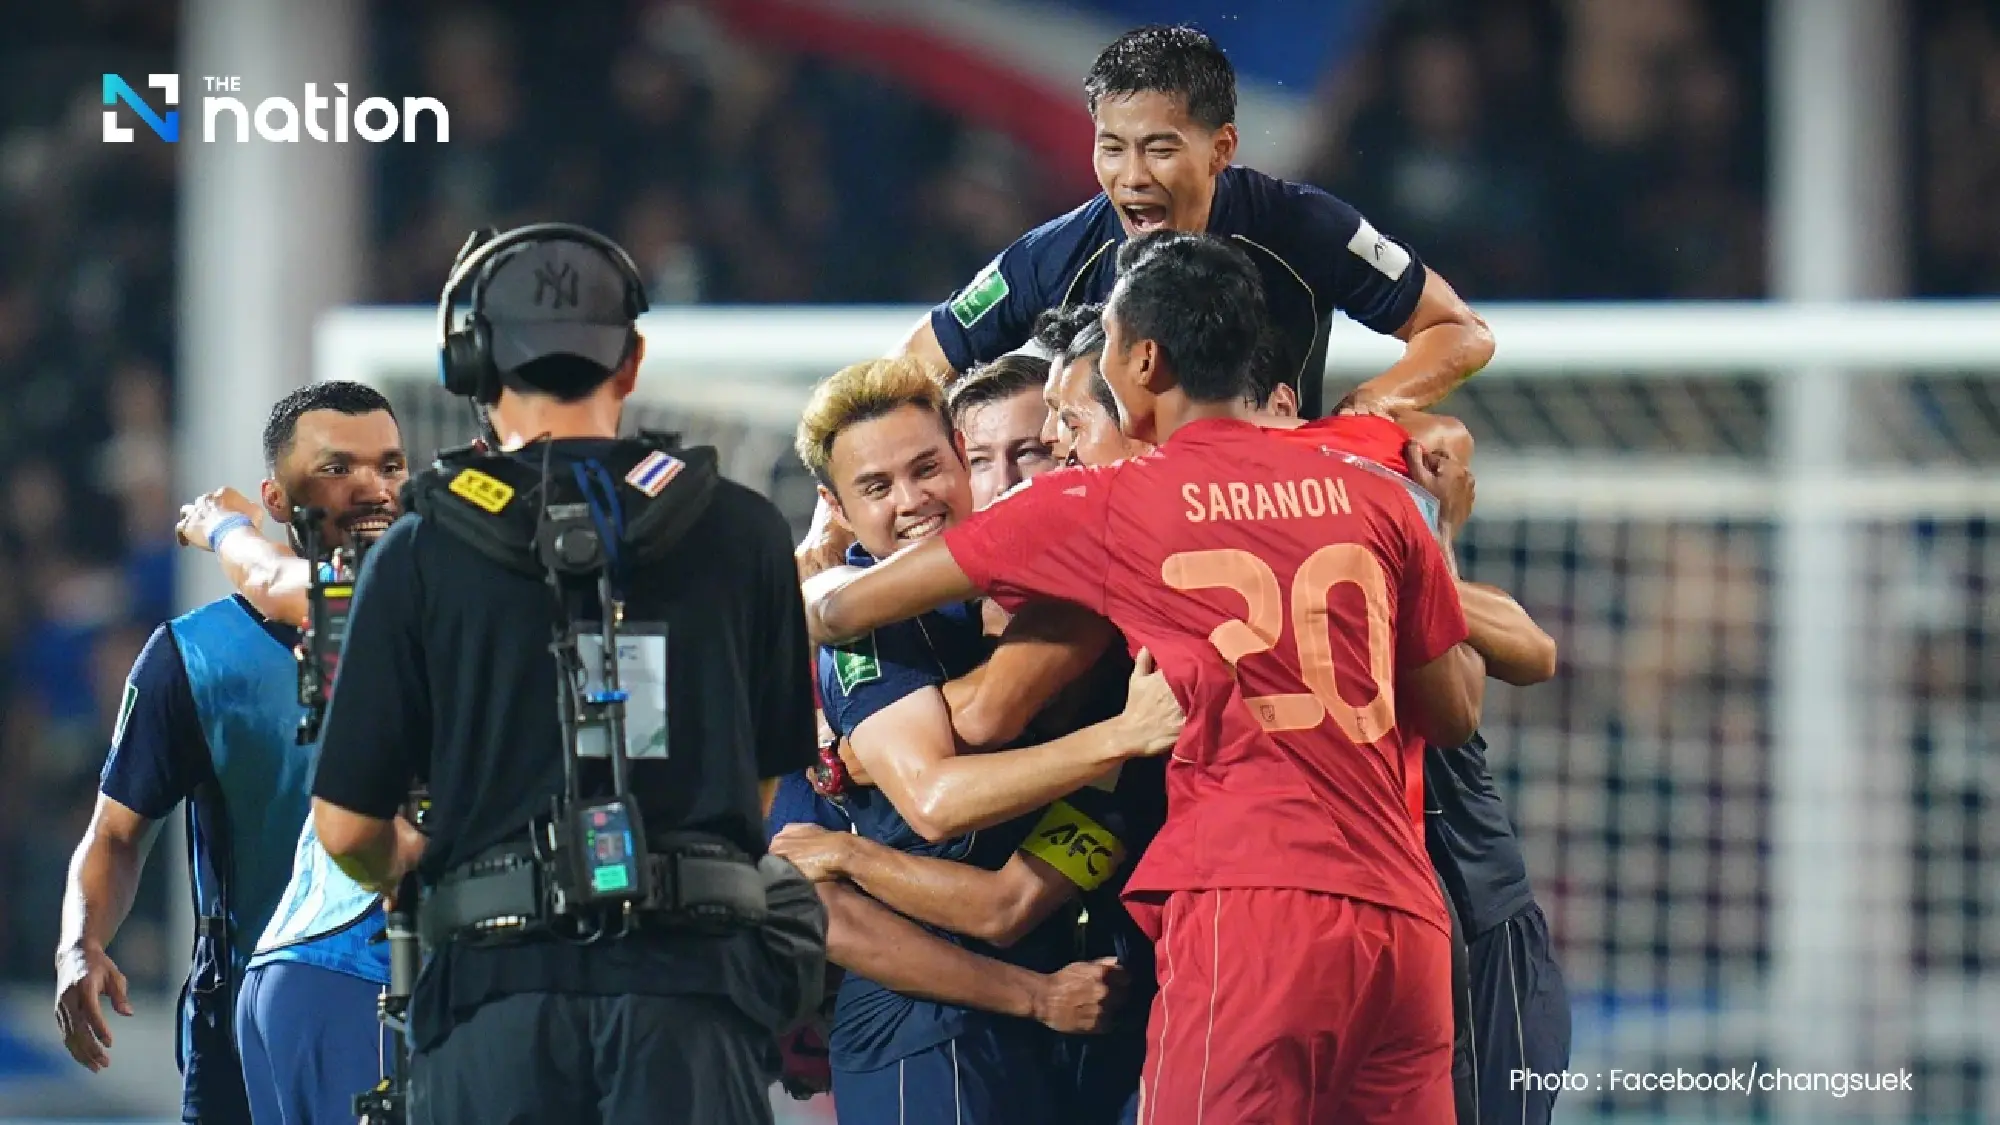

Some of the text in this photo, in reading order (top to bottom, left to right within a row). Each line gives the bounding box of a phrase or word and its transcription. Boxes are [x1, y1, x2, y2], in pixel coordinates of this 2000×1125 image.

[1182, 477, 1352, 522] SARANON
[1161, 542, 1395, 743] 20
[1040, 823, 1114, 876] AFC
